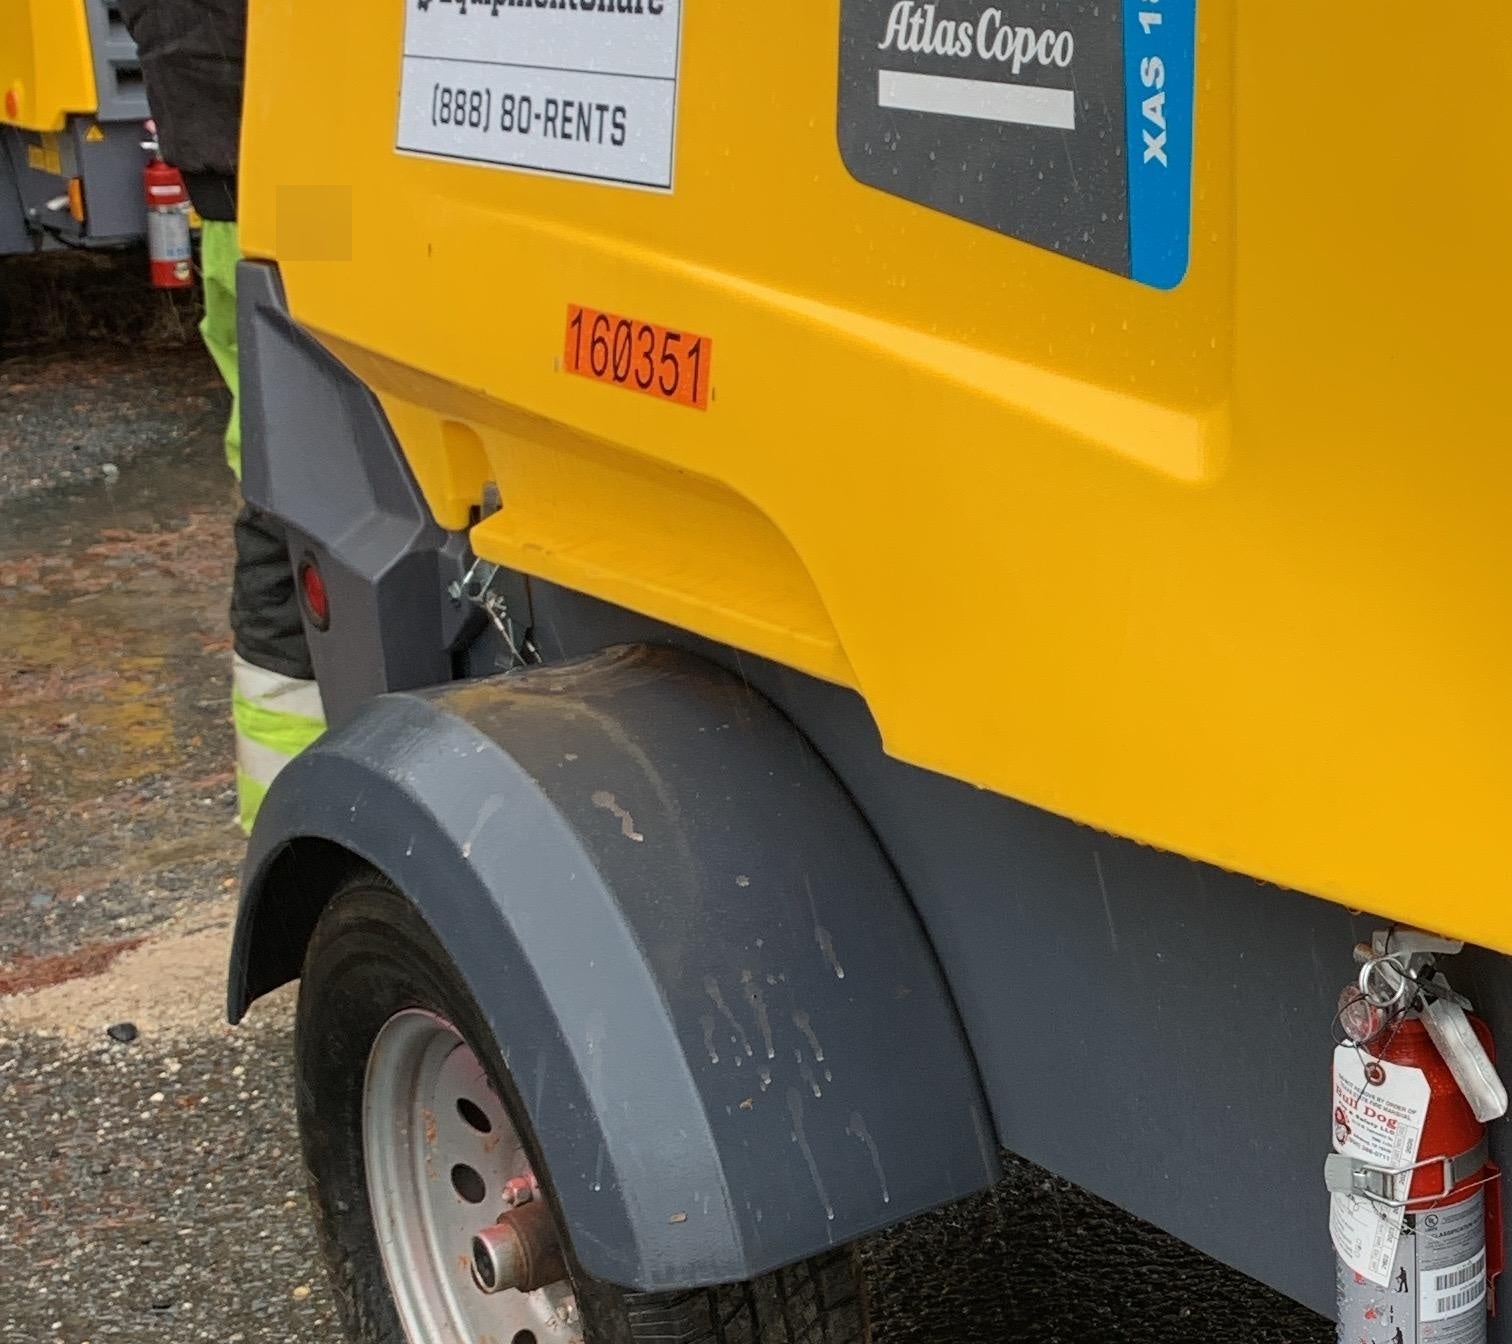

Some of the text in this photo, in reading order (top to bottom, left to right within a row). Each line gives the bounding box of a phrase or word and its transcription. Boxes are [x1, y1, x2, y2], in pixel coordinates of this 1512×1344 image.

[878, 0, 1075, 75] Atlas Copco
[430, 82, 628, 148] (888) 80-RENTS
[1142, 54, 1168, 169] XAS
[569, 306, 703, 405] 160351
[1364, 1105, 1398, 1130] Dog
